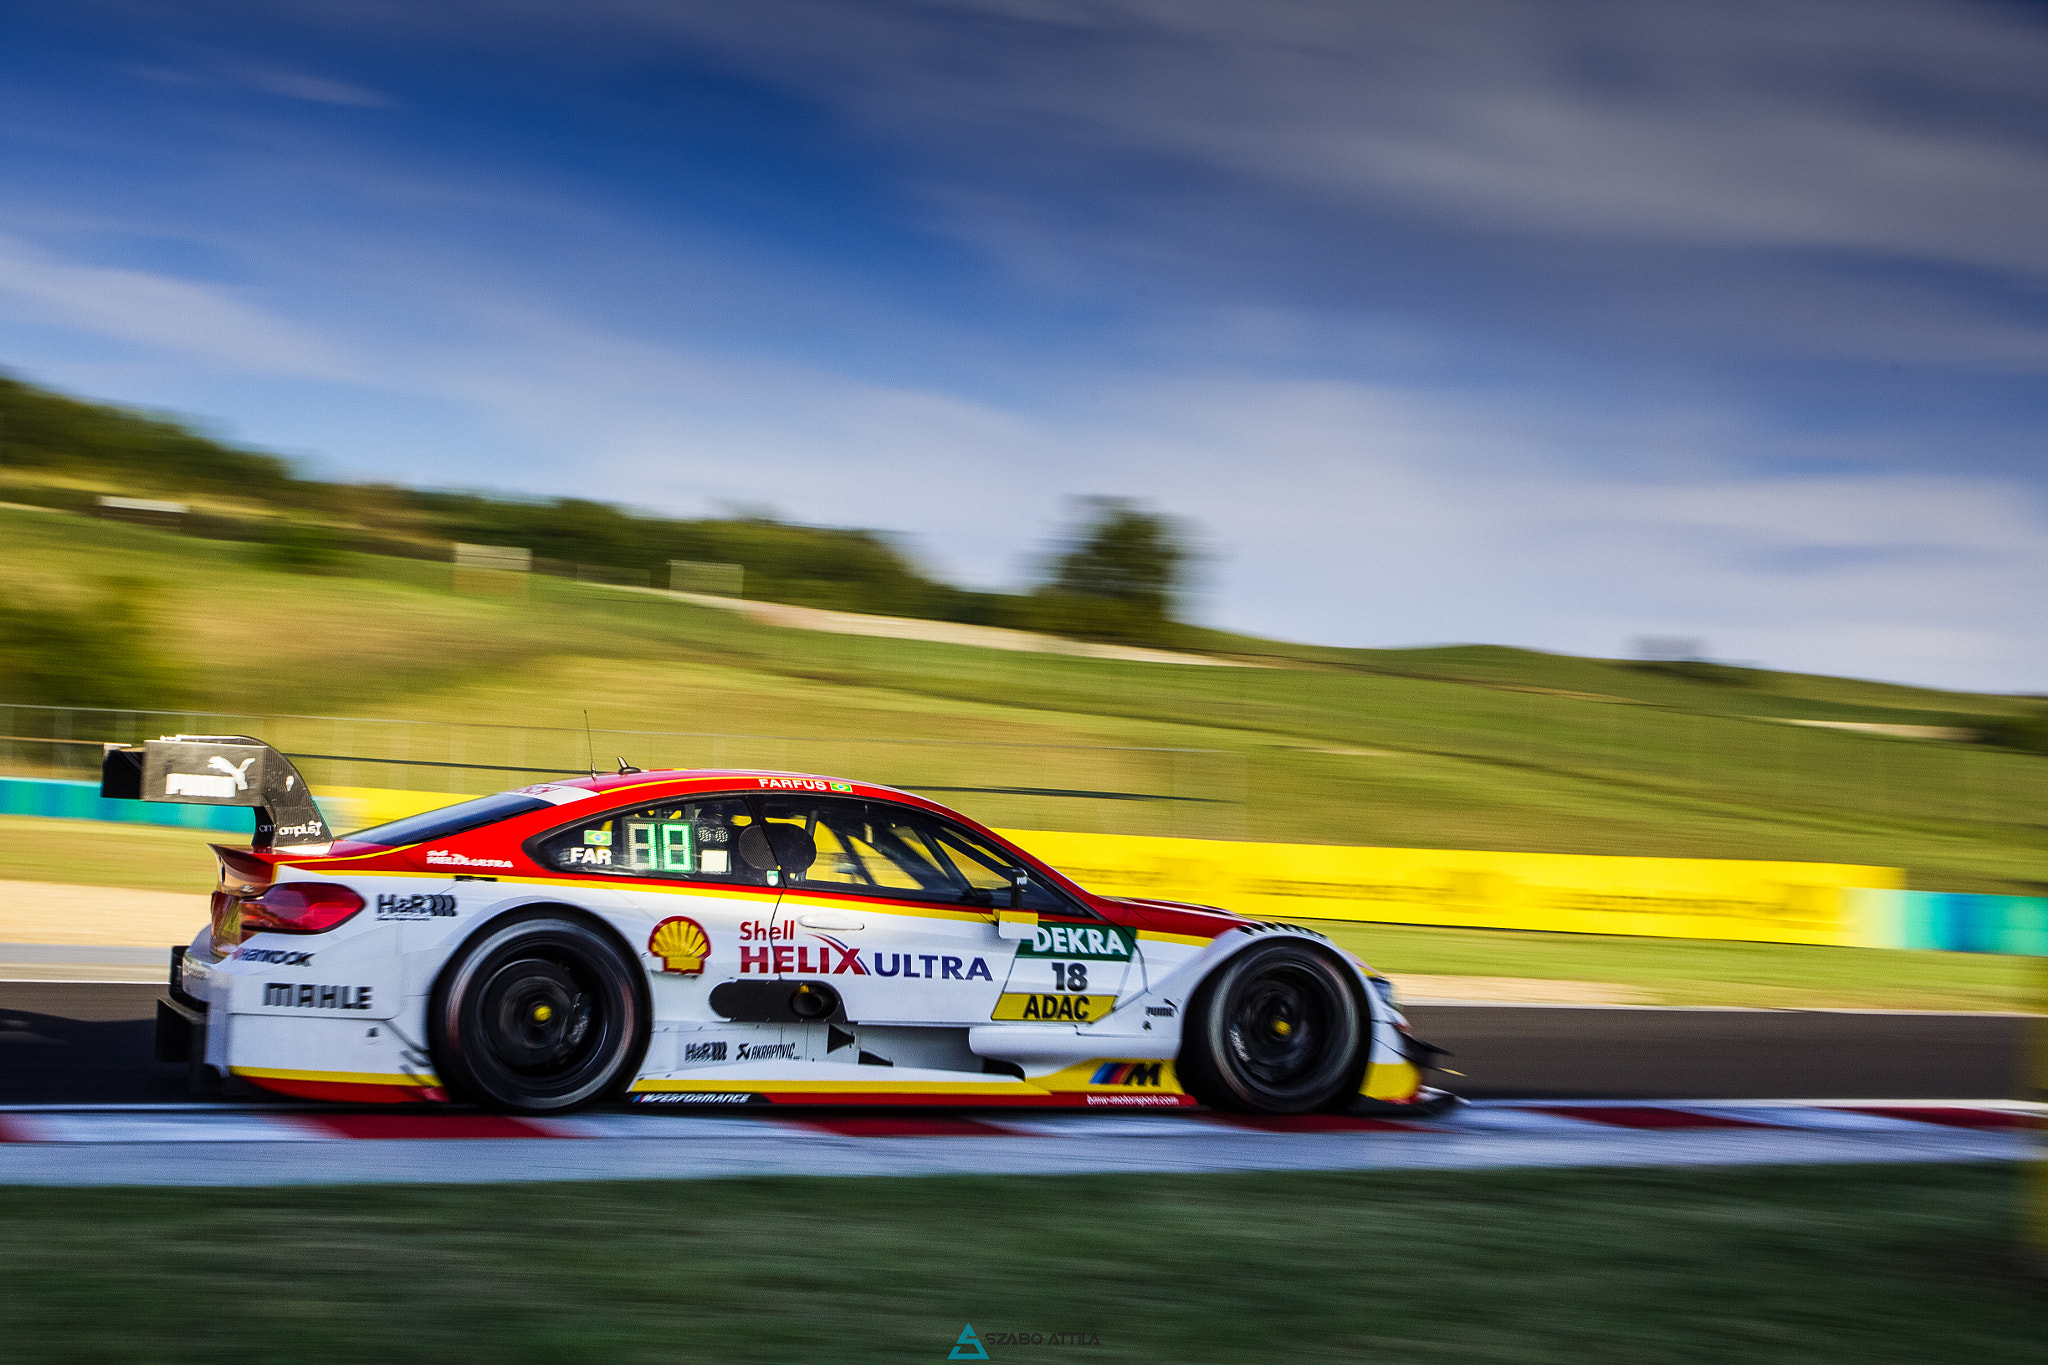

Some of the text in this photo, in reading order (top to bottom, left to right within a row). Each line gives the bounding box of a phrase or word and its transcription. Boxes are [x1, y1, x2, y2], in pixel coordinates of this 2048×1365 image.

[758, 778, 827, 791] FARFUS
[569, 847, 612, 866] FAR
[739, 919, 795, 941] Shell
[1032, 926, 1128, 956] DEKRA
[739, 945, 994, 982] HELIX ULTRA
[1052, 962, 1088, 992] 18
[263, 982, 373, 1009] MAHLE
[1023, 995, 1090, 1020] ADAC
